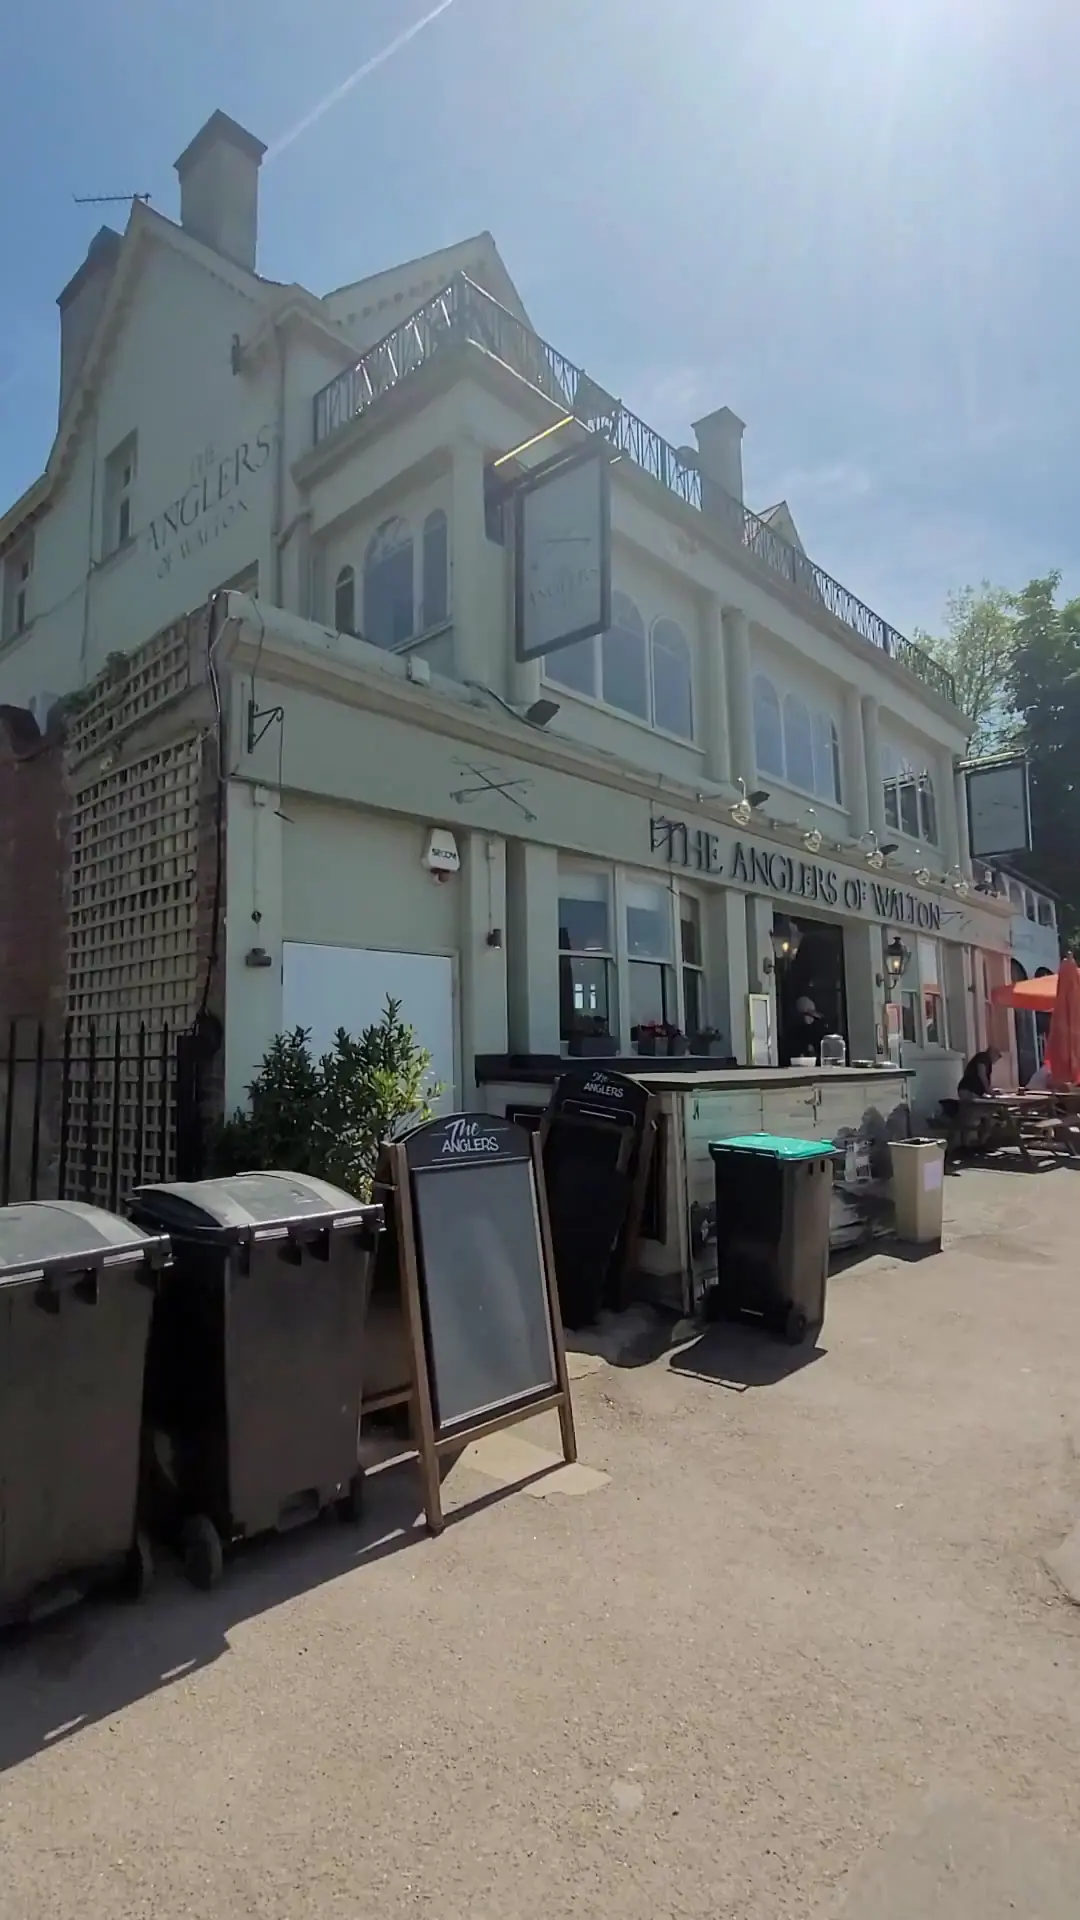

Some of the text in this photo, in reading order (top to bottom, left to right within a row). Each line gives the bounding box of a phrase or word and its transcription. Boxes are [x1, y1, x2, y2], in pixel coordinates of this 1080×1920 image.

[147, 424, 270, 551] ANGLERS
[663, 822, 941, 930] THE ANGLERS OF WALTON
[584, 1082, 624, 1098] ANGLERS
[442, 1136, 500, 1153] ANGLERS
[444, 1119, 480, 1145] The
